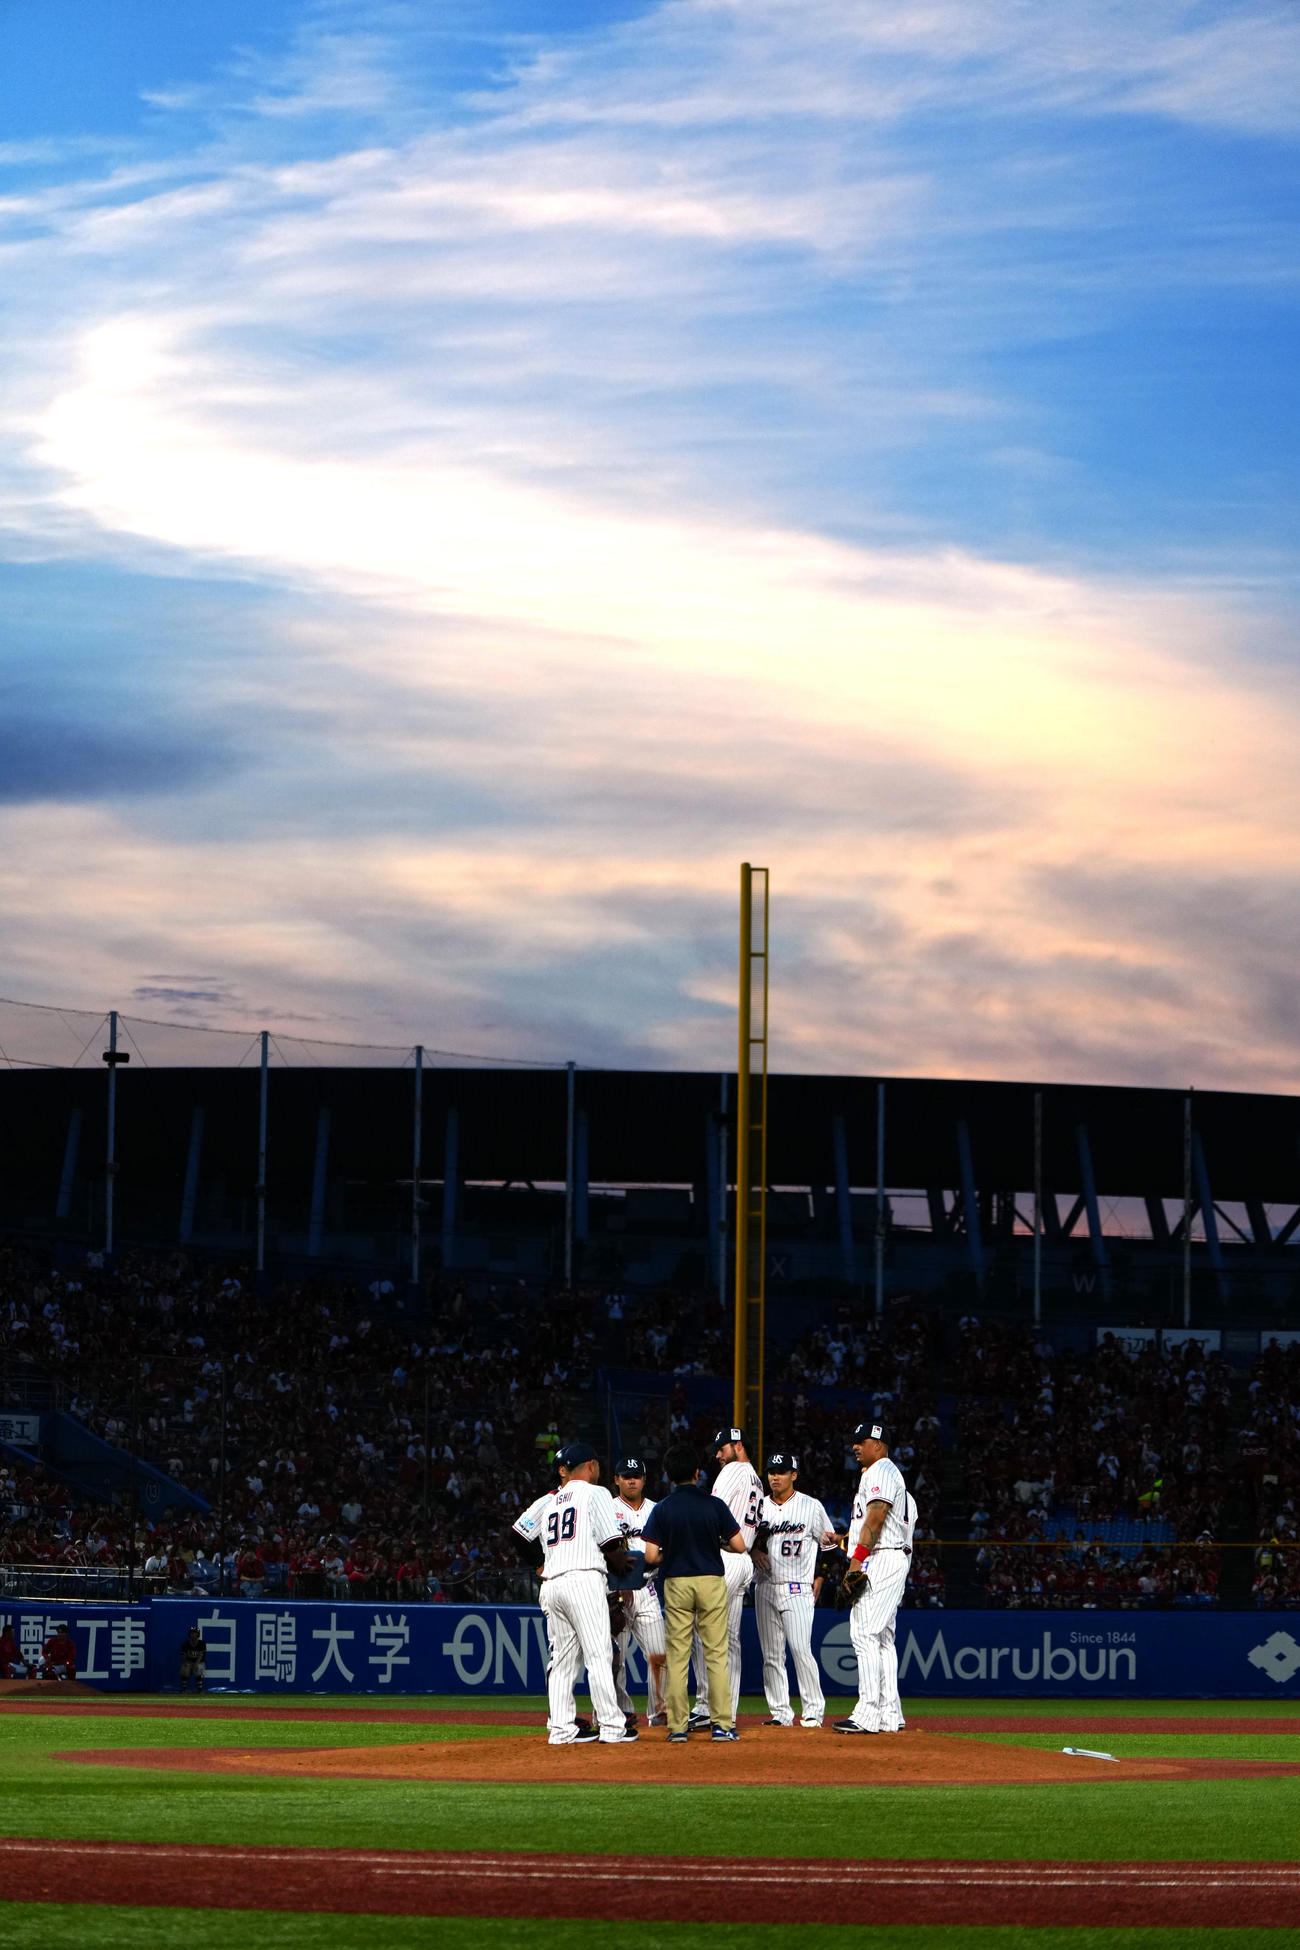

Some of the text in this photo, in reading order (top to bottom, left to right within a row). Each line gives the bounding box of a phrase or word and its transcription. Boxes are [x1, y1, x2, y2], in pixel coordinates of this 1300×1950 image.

[1072, 1272, 1096, 1293] W
[556, 1491, 573, 1506] ISHII
[547, 1507, 577, 1547] 98
[781, 1540, 803, 1557] 67
[1070, 1632, 1136, 1644] Since 1844
[898, 1629, 1136, 1680] Marubun
